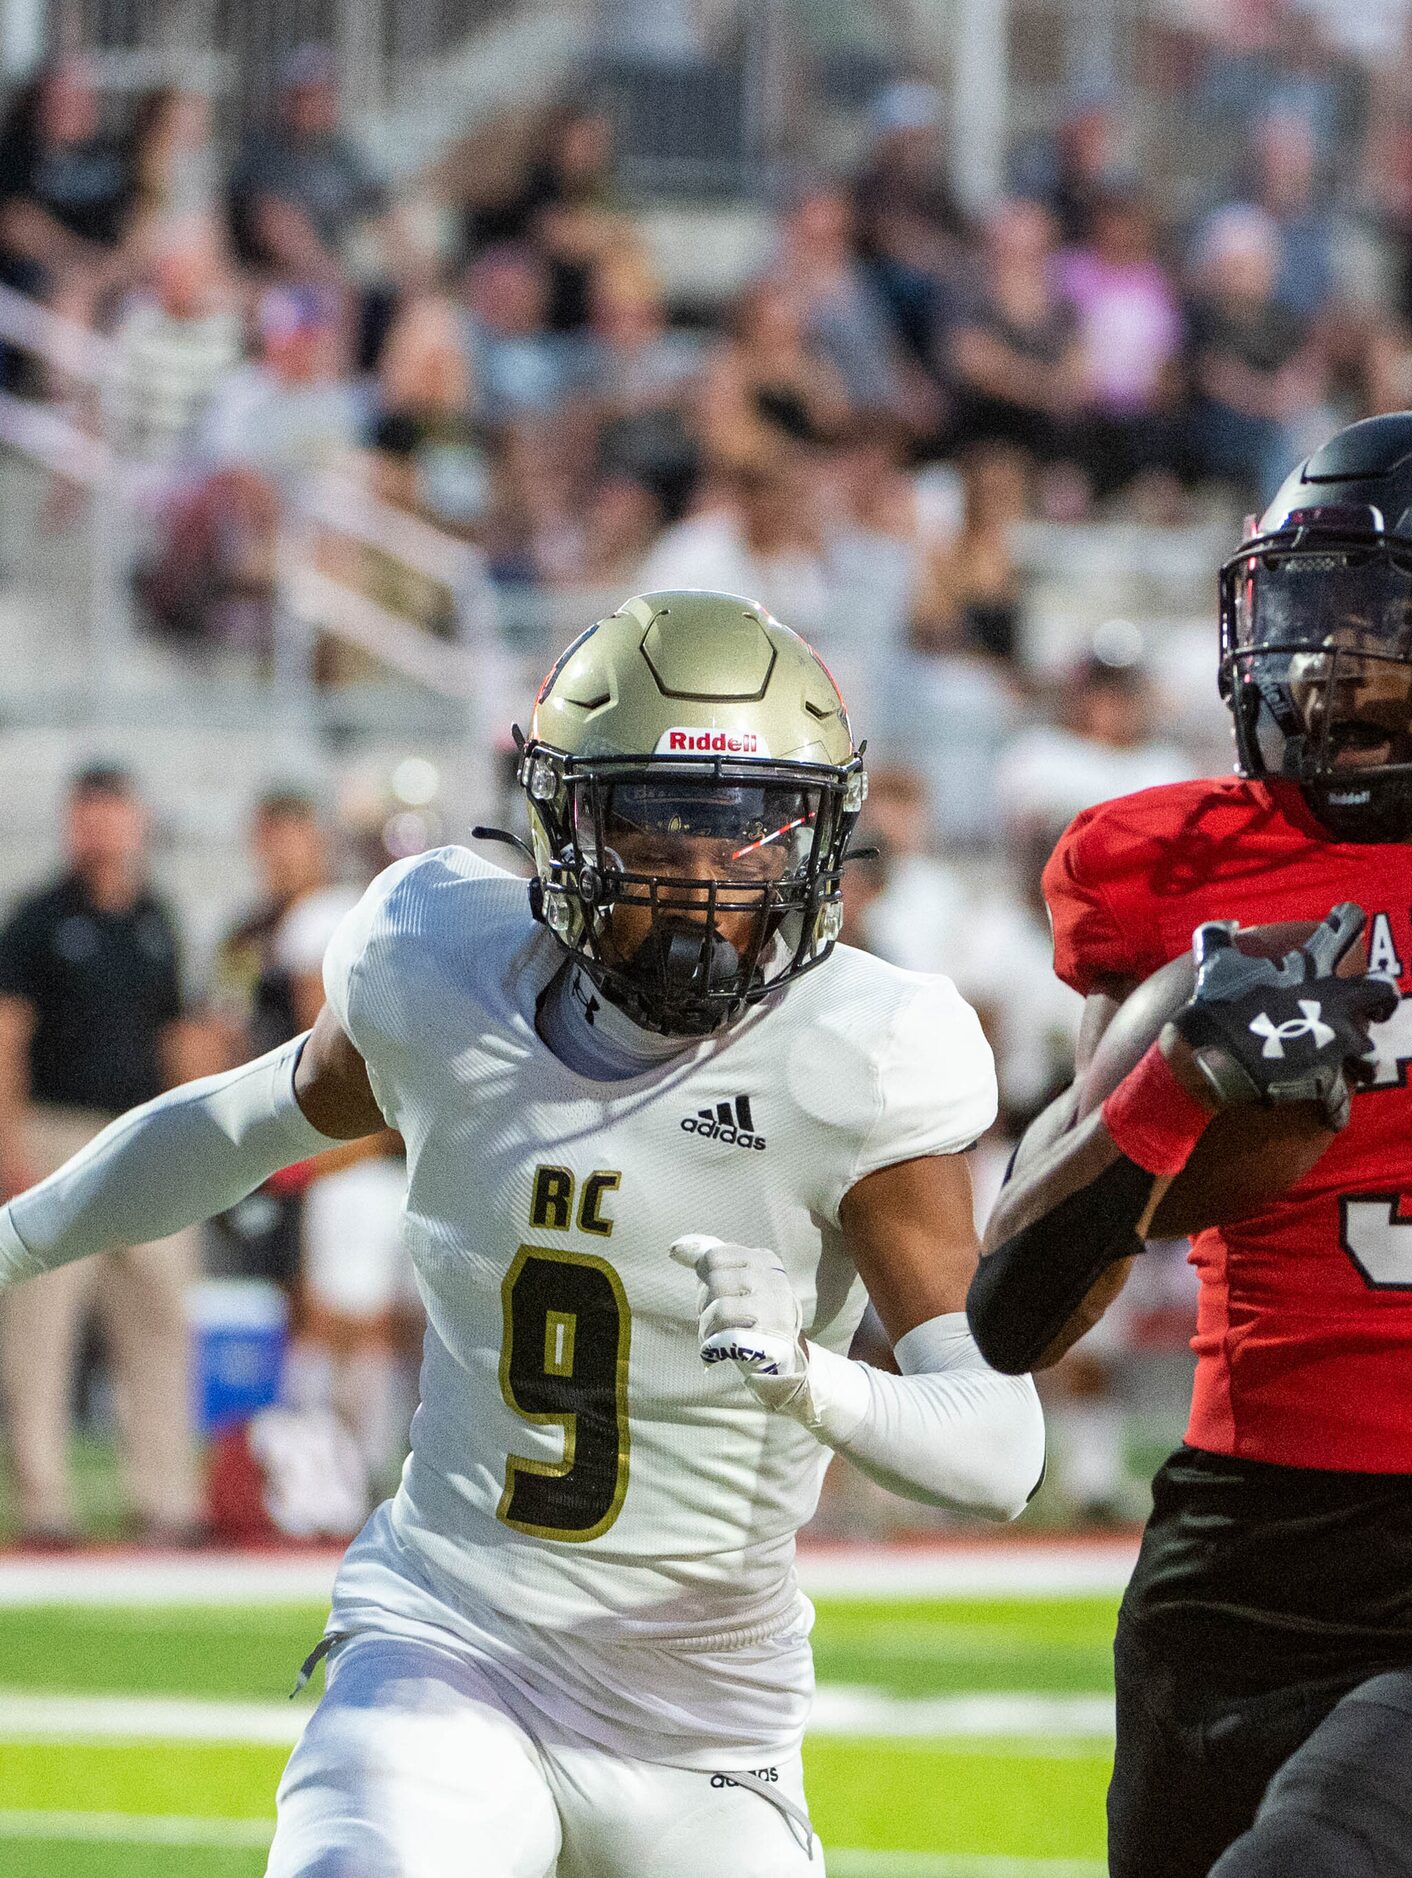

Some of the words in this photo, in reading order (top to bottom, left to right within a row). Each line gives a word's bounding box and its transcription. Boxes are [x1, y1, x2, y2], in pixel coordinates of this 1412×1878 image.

[669, 731, 757, 752] Riddell
[680, 1118, 767, 1151] adidas
[528, 1163, 622, 1238] RC
[496, 1242, 632, 1543] 9
